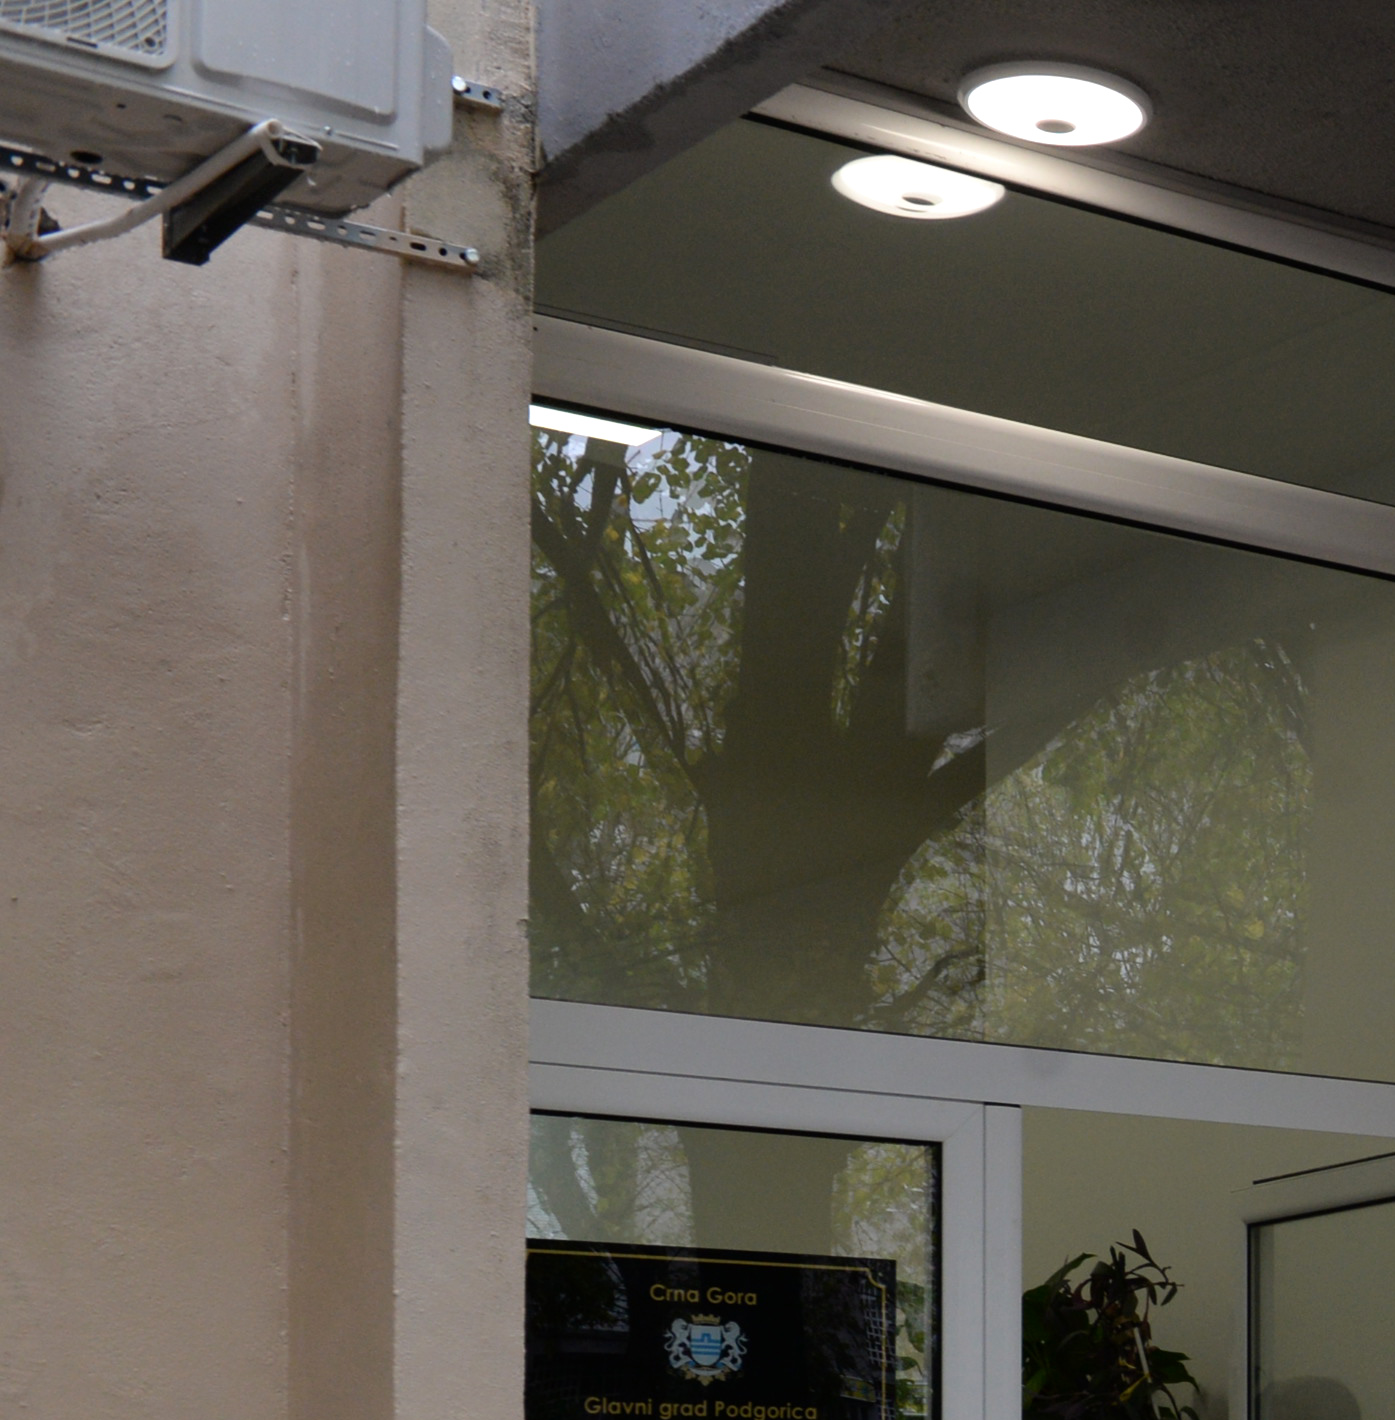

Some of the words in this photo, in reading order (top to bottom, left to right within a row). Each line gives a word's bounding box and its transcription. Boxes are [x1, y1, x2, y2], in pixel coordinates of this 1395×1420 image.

[650, 1284, 699, 1304] Crna
[706, 1286, 757, 1306] Gora
[584, 1397, 653, 1417] Glavni
[659, 1399, 707, 1420] grad
